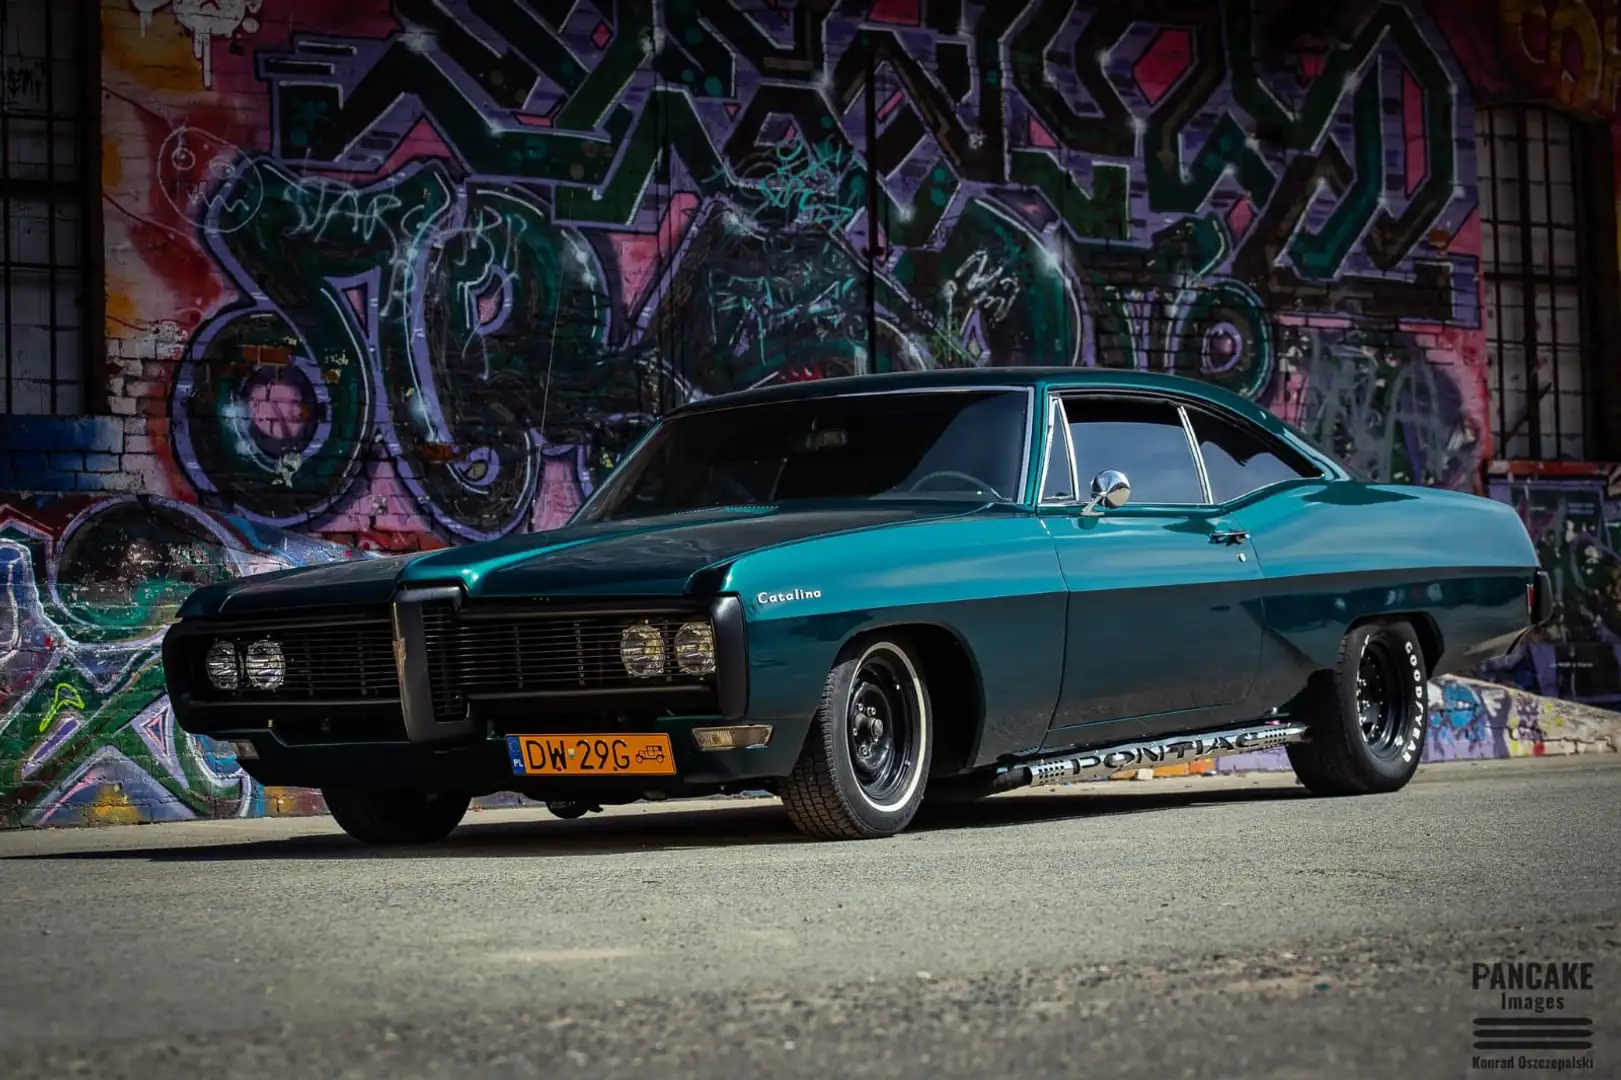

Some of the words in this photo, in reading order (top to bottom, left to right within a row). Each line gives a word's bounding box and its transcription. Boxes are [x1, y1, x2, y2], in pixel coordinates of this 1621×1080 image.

[757, 588, 822, 604] Catalina
[1403, 641, 1424, 763] GOODYEAR
[513, 758, 524, 768] PL
[525, 740, 567, 770] DW
[576, 739, 630, 770] 29G
[1072, 732, 1258, 775] PONTIAC
